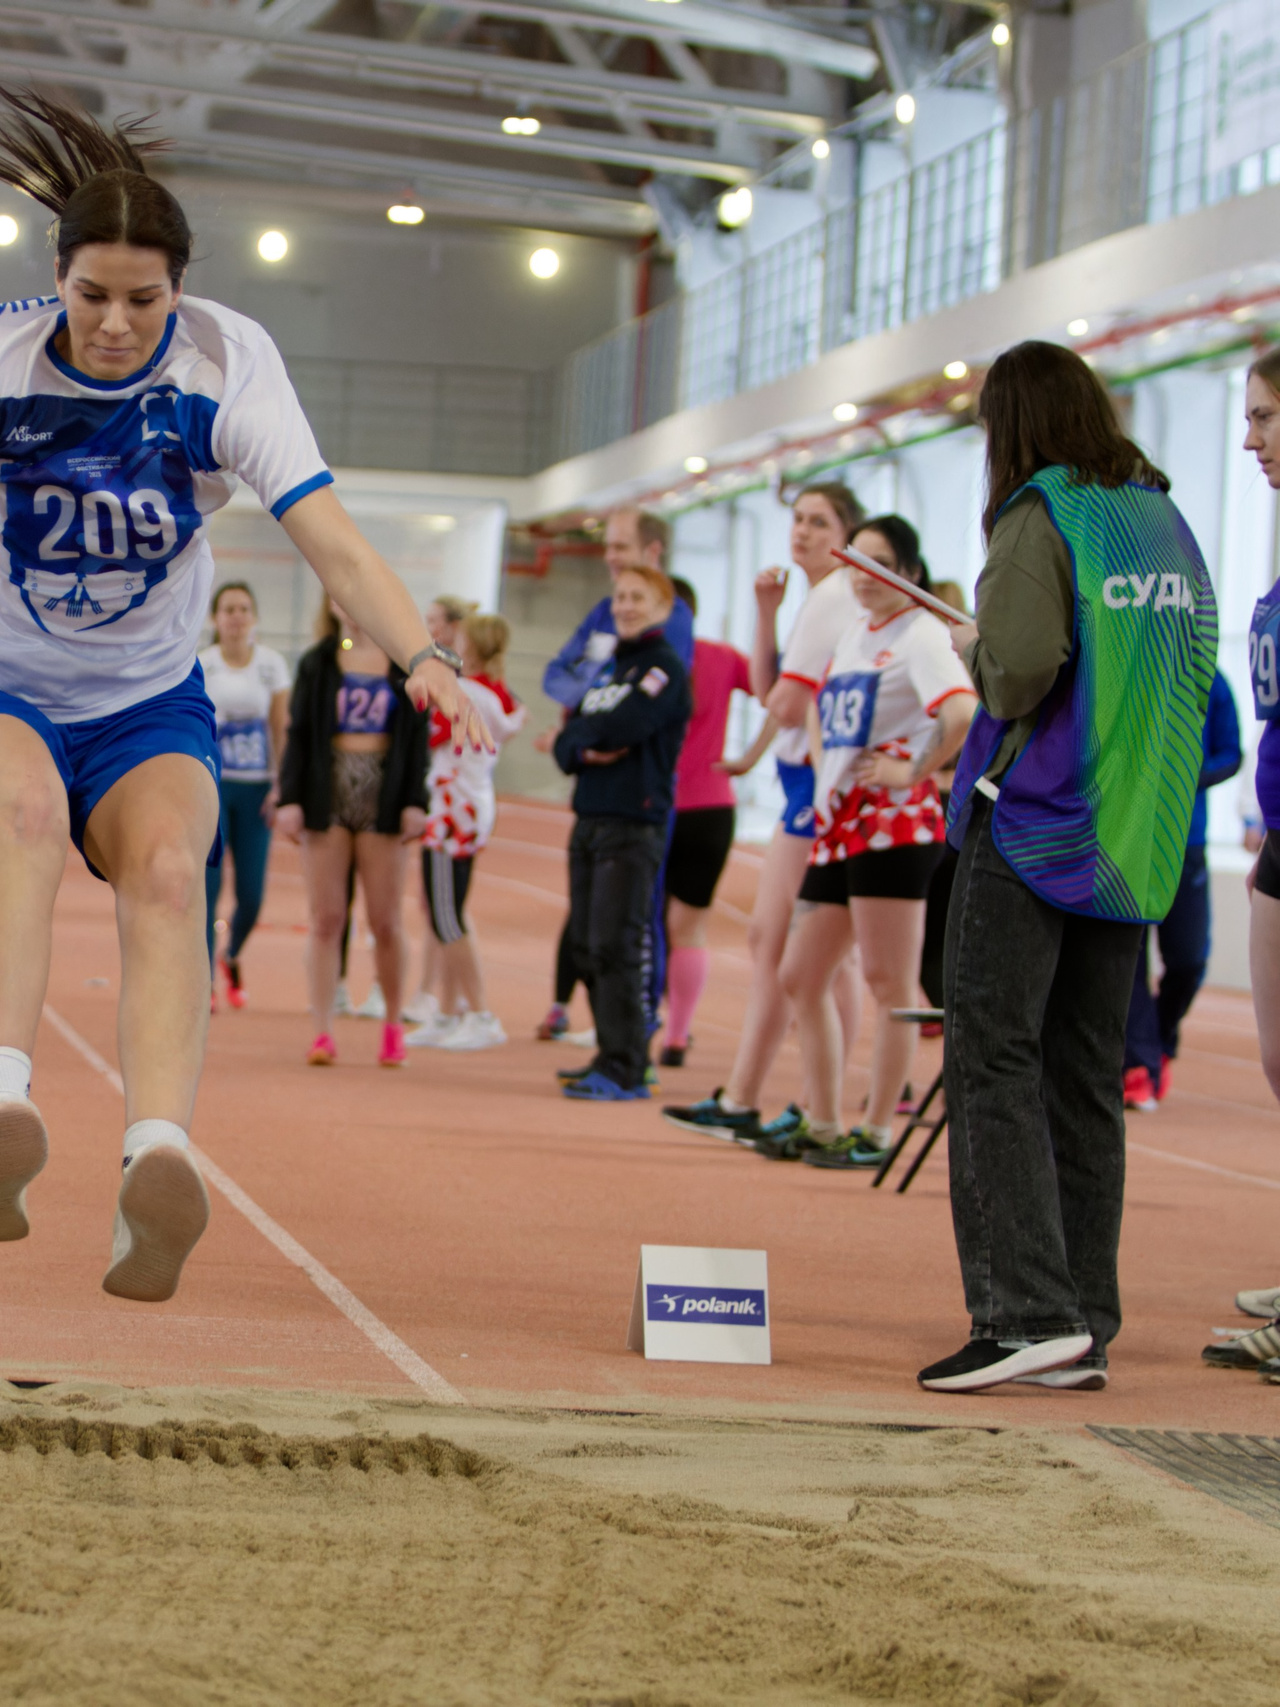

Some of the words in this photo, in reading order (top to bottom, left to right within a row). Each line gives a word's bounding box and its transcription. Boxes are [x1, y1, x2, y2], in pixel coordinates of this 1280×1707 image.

[66, 454, 121, 464] ВСЕРОССИЙСКИЙ
[33, 484, 178, 560] 209
[336, 686, 391, 727] 124
[821, 689, 865, 740] 243
[681, 1296, 757, 1316] polanik
